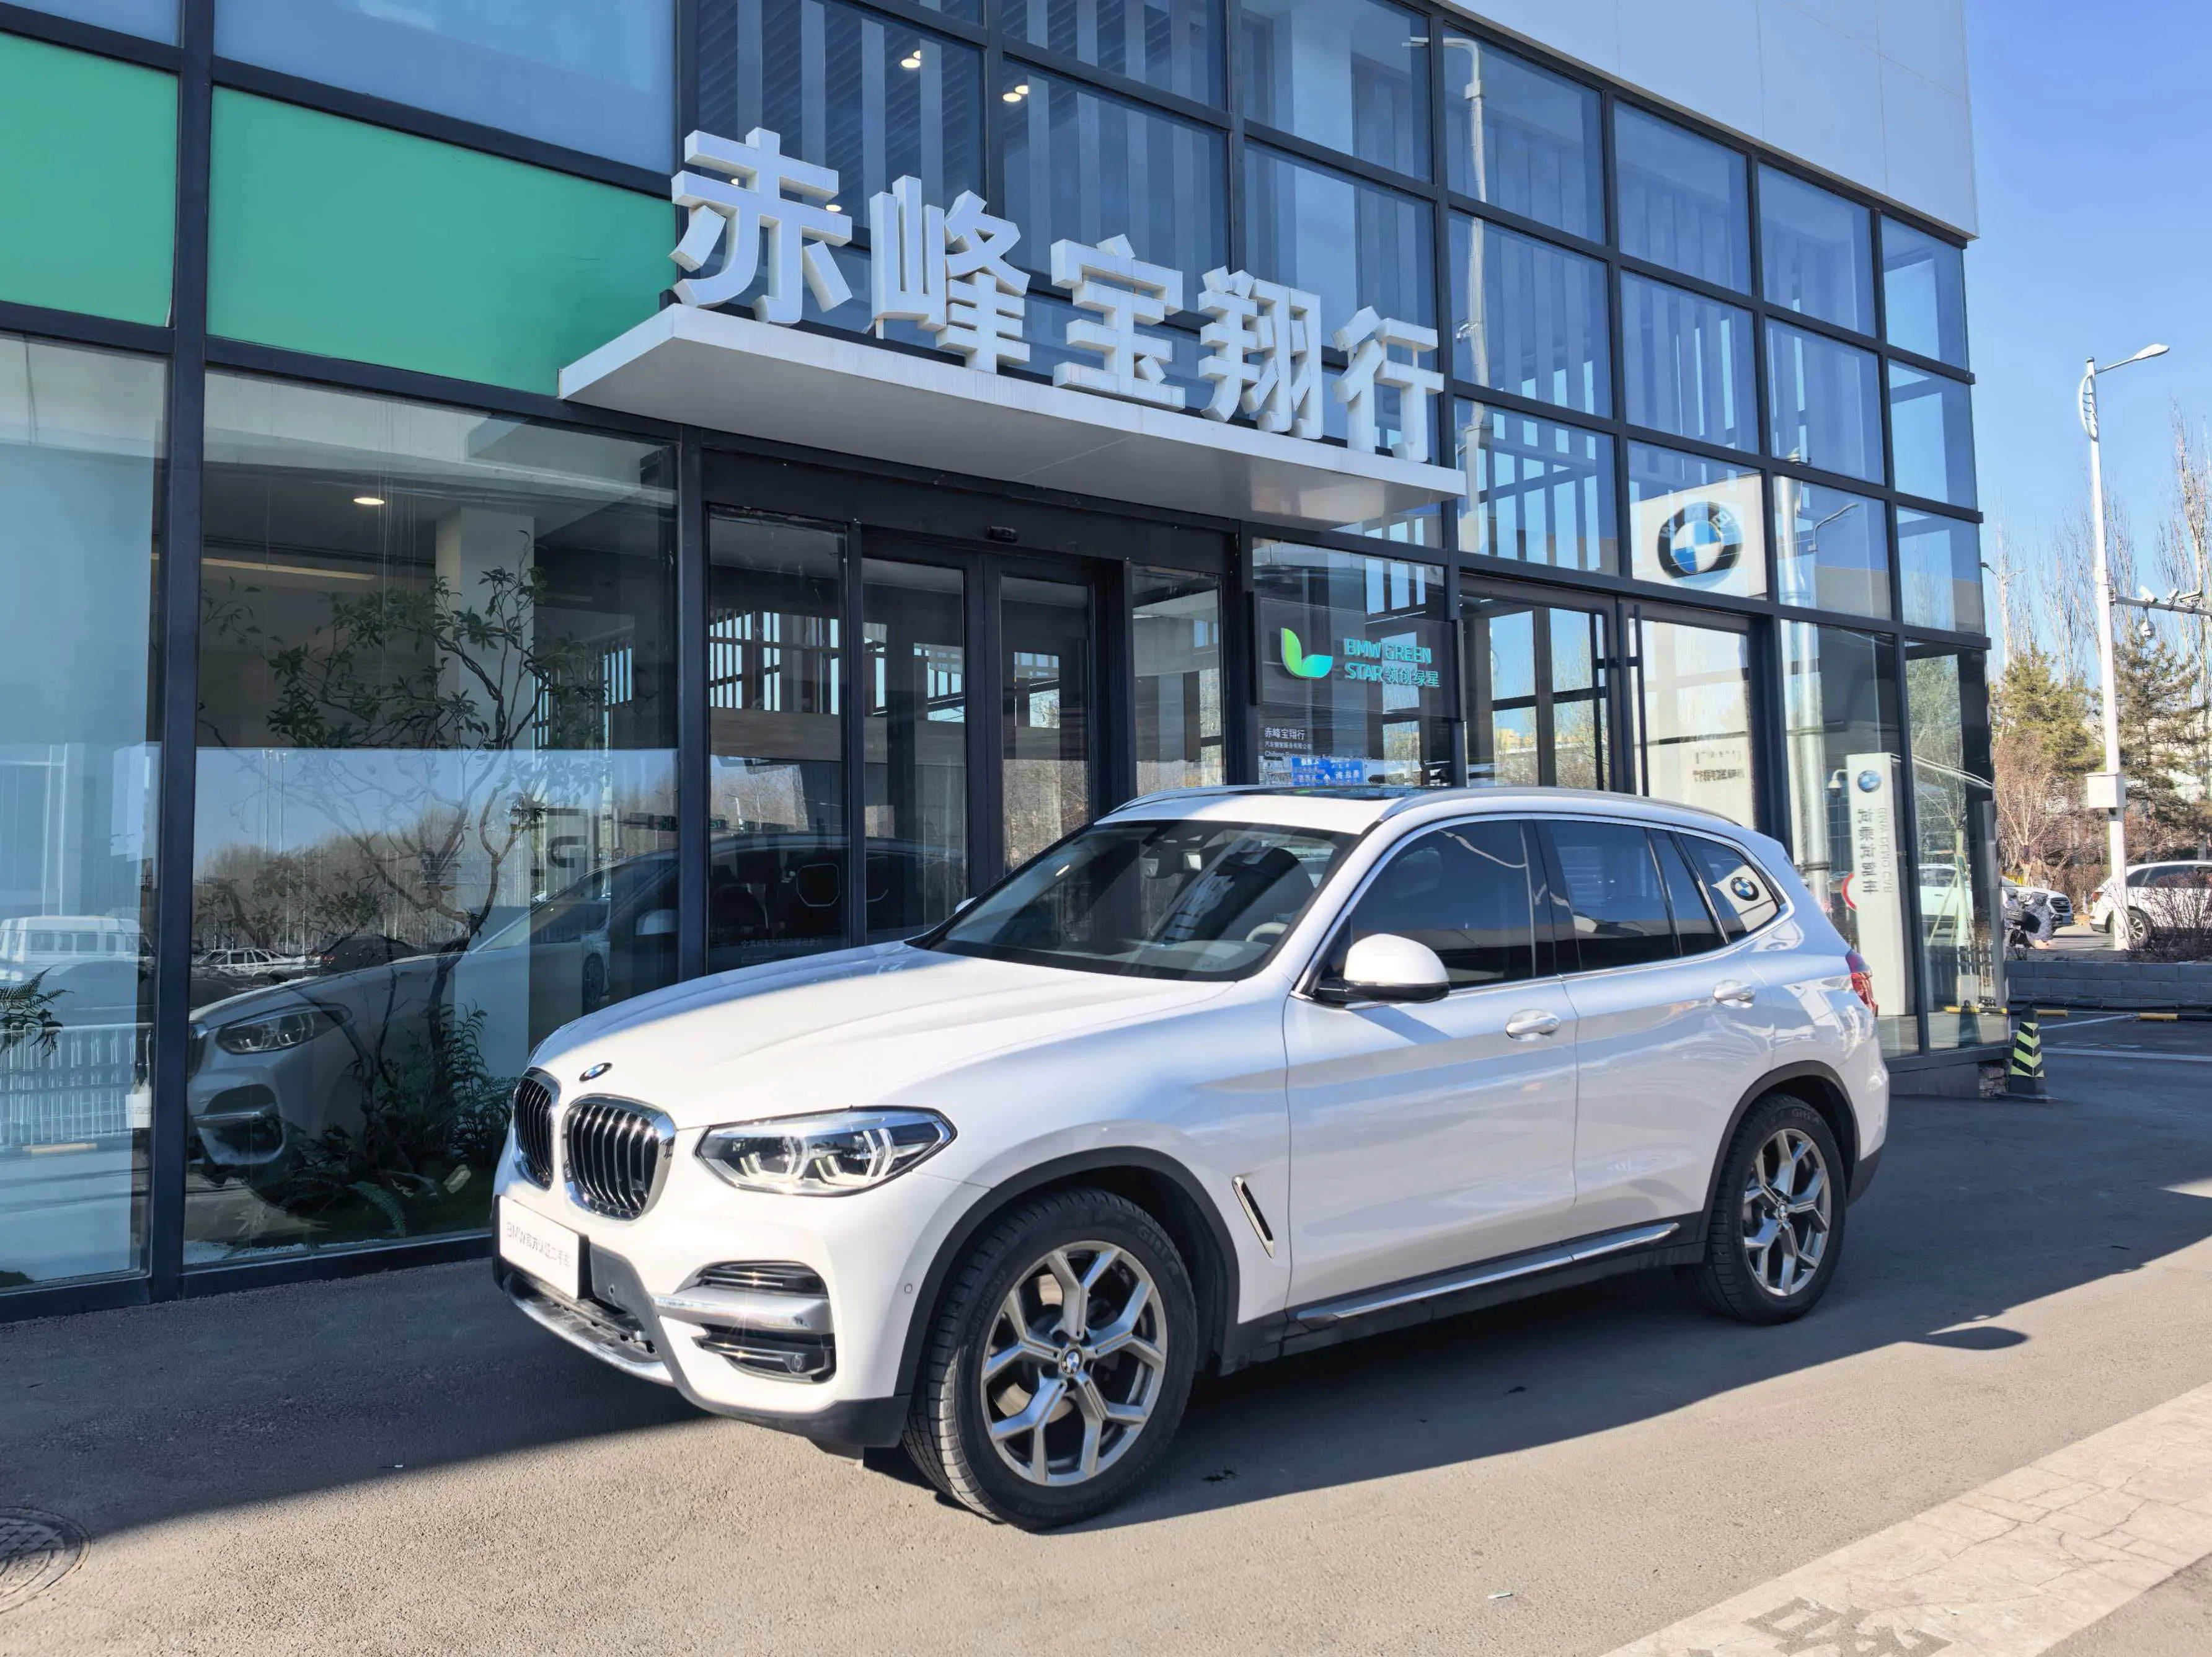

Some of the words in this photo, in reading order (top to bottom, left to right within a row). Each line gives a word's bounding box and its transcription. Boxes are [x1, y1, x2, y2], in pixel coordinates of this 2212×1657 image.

[670, 127, 1444, 463] 赤峰宝翔行
[1344, 638, 1381, 659] BMW
[1385, 644, 1432, 664] GREEN
[1344, 662, 1383, 682] STAR
[1384, 666, 1440, 688] 领创绿星
[1265, 727, 1305, 740] 赤峰宝翔行
